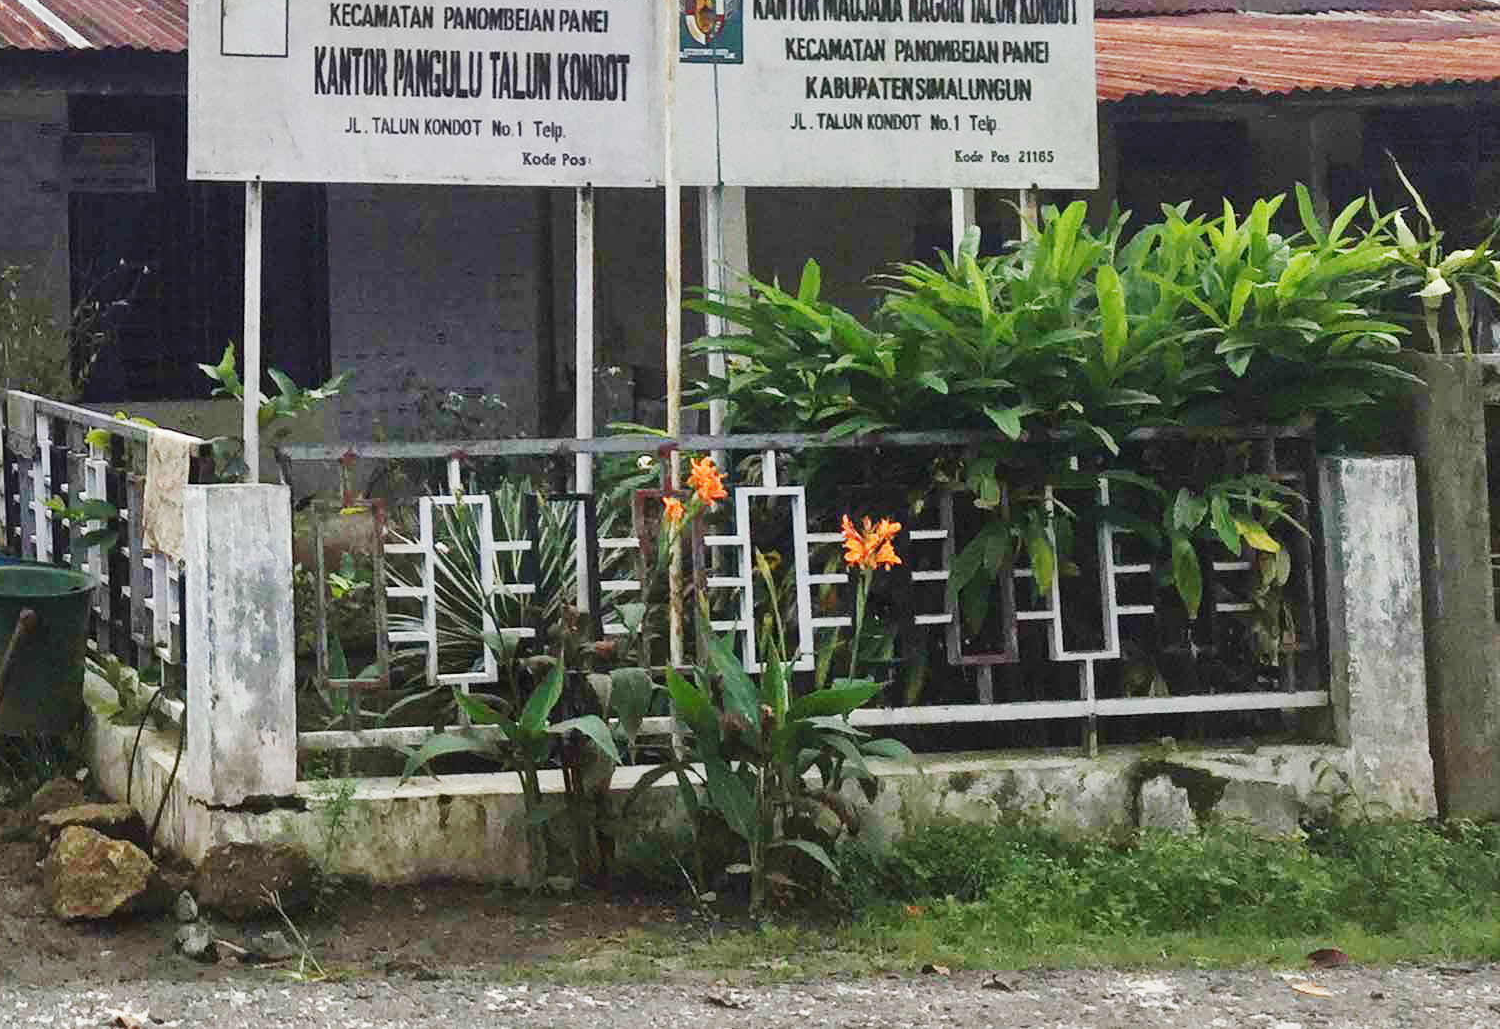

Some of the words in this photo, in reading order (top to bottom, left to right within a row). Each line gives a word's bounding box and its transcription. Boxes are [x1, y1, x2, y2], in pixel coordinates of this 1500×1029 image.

[329, 2, 434, 28] KECAMATAN
[444, 6, 555, 32] PANOMBEIAN
[559, 9, 609, 33] PANEI
[785, 37, 885, 62] KECAMATAN
[895, 39, 998, 63] PANOMBEIAN
[1003, 40, 1049, 64] PANEI
[313, 45, 388, 97] KANTOR
[393, 48, 482, 99] PANGULU
[489, 51, 551, 100] TALUN
[557, 54, 630, 102] KONDOT
[806, 76, 914, 100] KABUPATEN
[916, 77, 1032, 101] SIMALUNGUN
[345, 117, 368, 134] JL.
[372, 117, 419, 135] TALUN
[424, 118, 482, 136] KONDOT
[534, 120, 566, 142] Telp.
[790, 113, 813, 130] JL.
[817, 113, 862, 130] TALUN
[867, 114, 921, 131] KONDOT
[522, 152, 556, 166] Kode
[955, 150, 984, 163] Kode
[991, 150, 1010, 163] Pos
[1018, 150, 1054, 163] 21165
